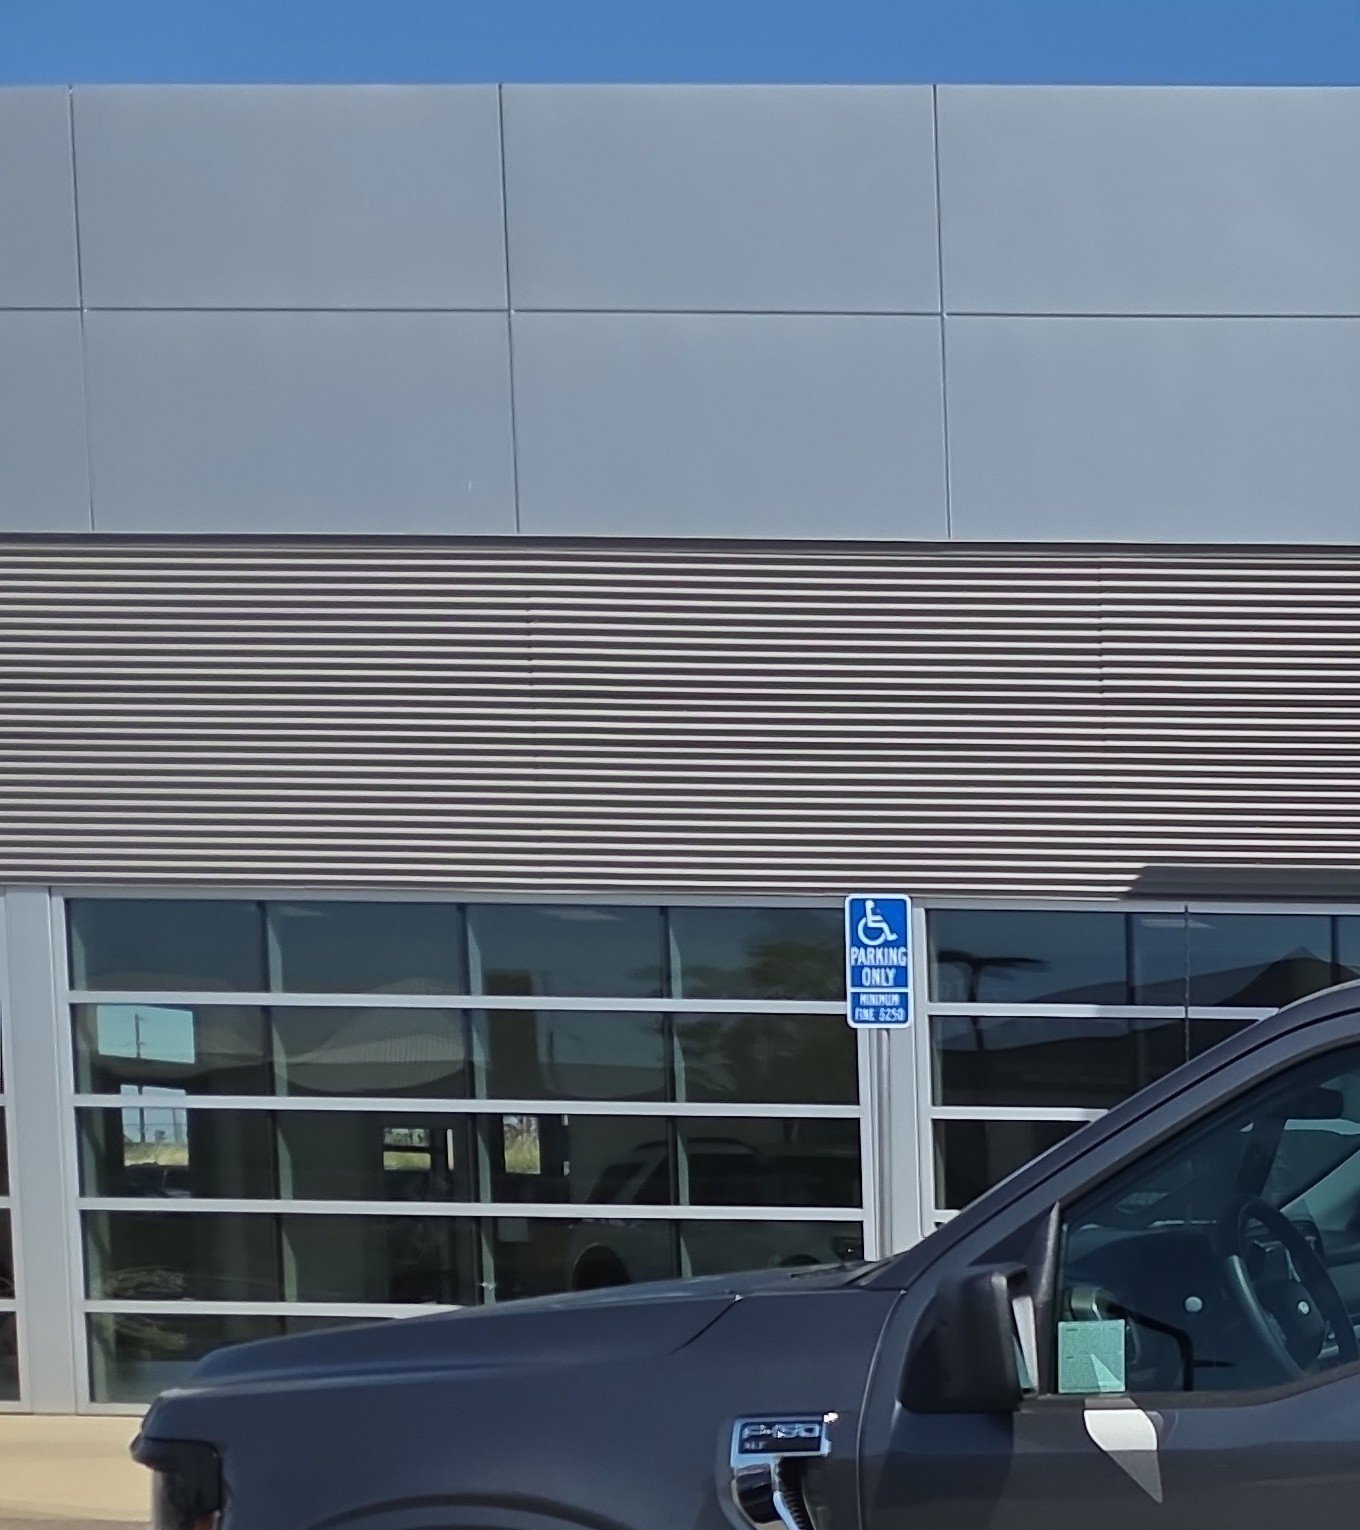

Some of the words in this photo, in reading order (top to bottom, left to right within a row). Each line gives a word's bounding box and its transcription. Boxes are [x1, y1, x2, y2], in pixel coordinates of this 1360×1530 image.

[850, 946, 908, 967] PARKING
[861, 966, 897, 987] ONLY
[859, 993, 900, 1006] MINIMUM
[855, 1007, 875, 1021] FINE
